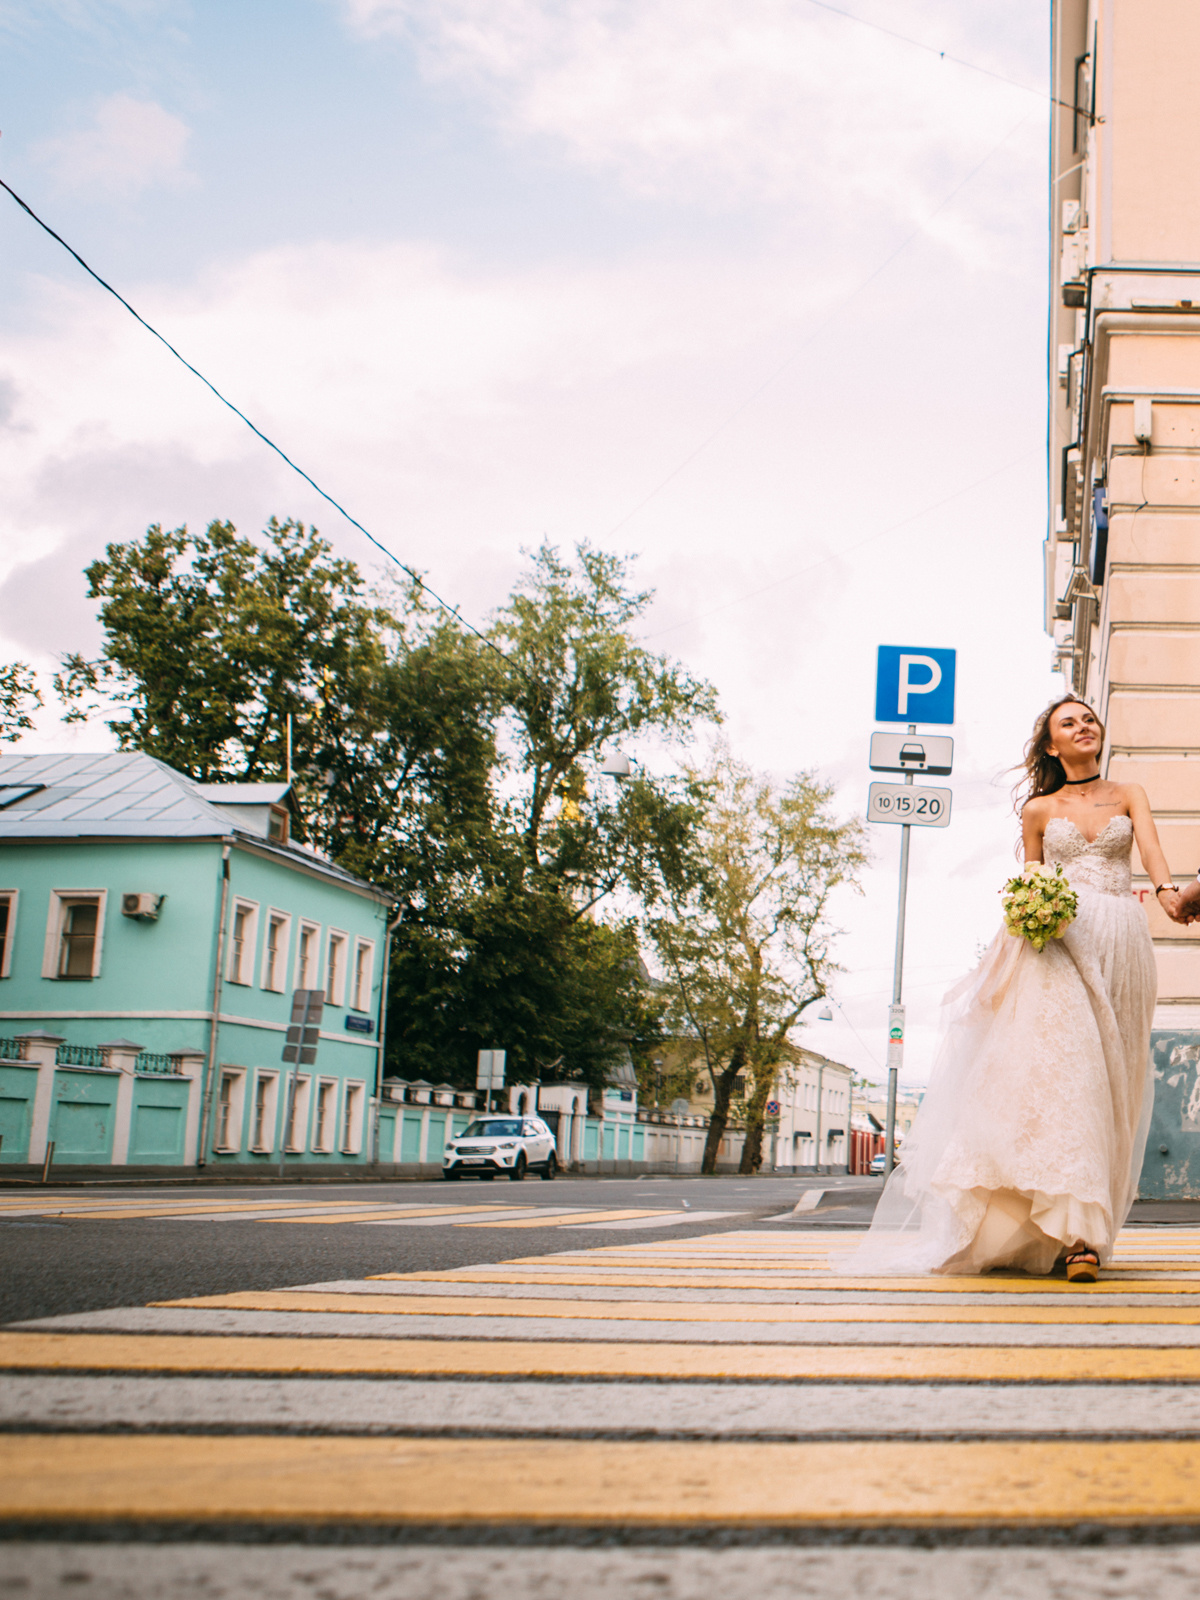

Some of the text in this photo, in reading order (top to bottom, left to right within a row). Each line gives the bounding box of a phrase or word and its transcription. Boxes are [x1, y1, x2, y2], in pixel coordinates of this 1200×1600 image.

[897, 654, 942, 715] P
[879, 797, 940, 815] 10 15 20
